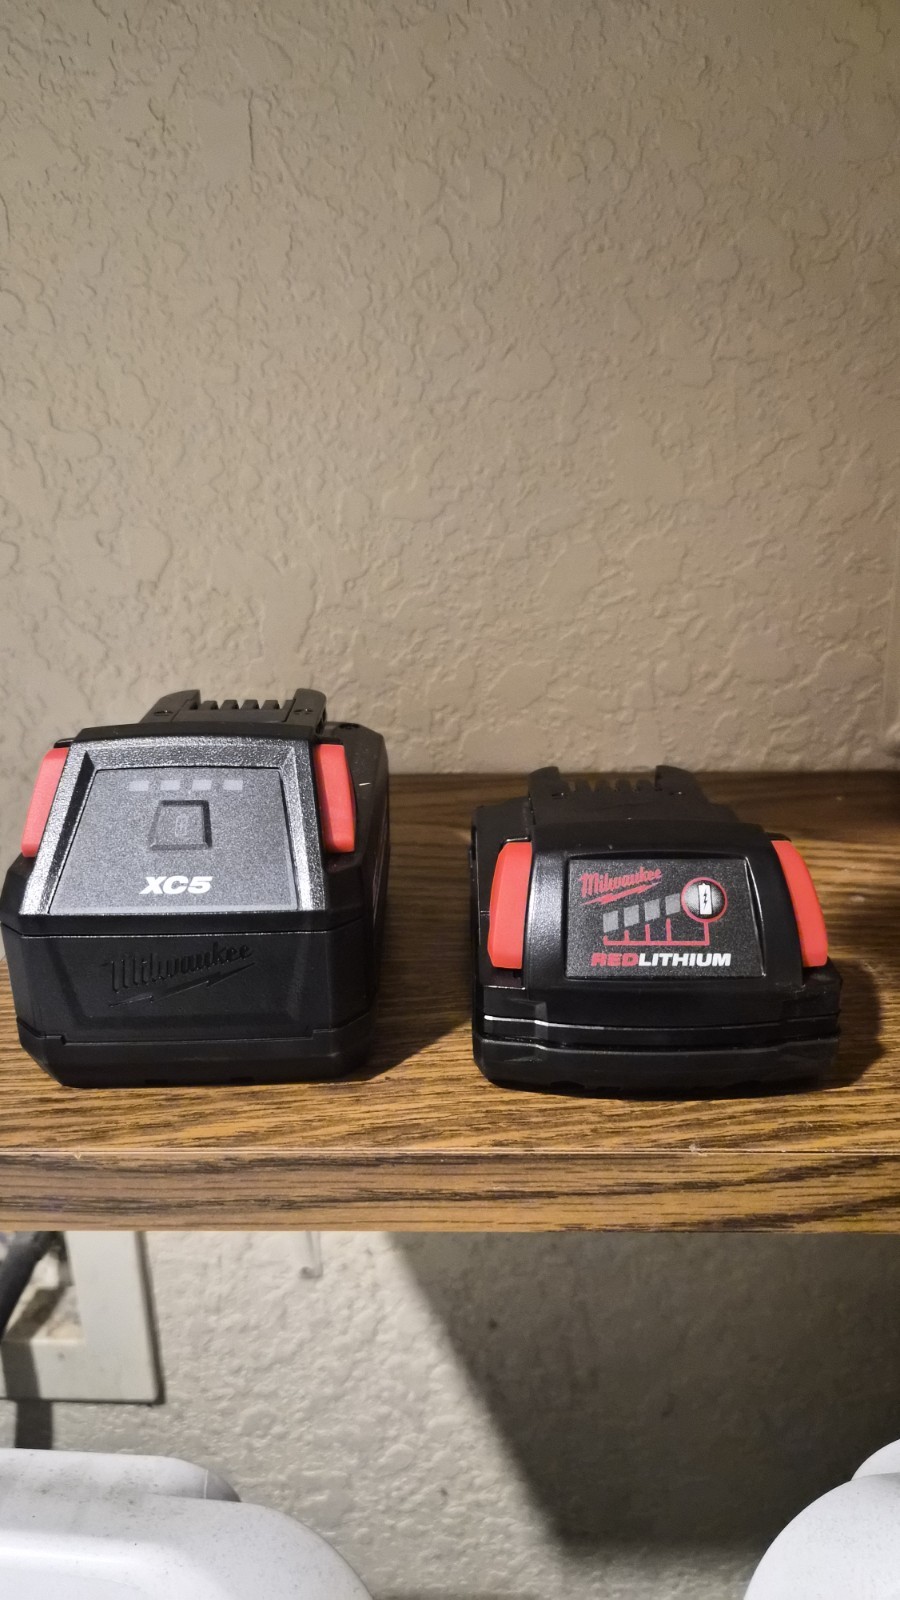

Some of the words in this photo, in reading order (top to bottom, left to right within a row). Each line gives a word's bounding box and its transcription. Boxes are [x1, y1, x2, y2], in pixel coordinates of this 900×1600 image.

[139, 875, 214, 895] XC5
[580, 867, 662, 898] Milwaukee
[104, 941, 254, 994] Milwaukee
[591, 952, 731, 967] REDLITHIUM
